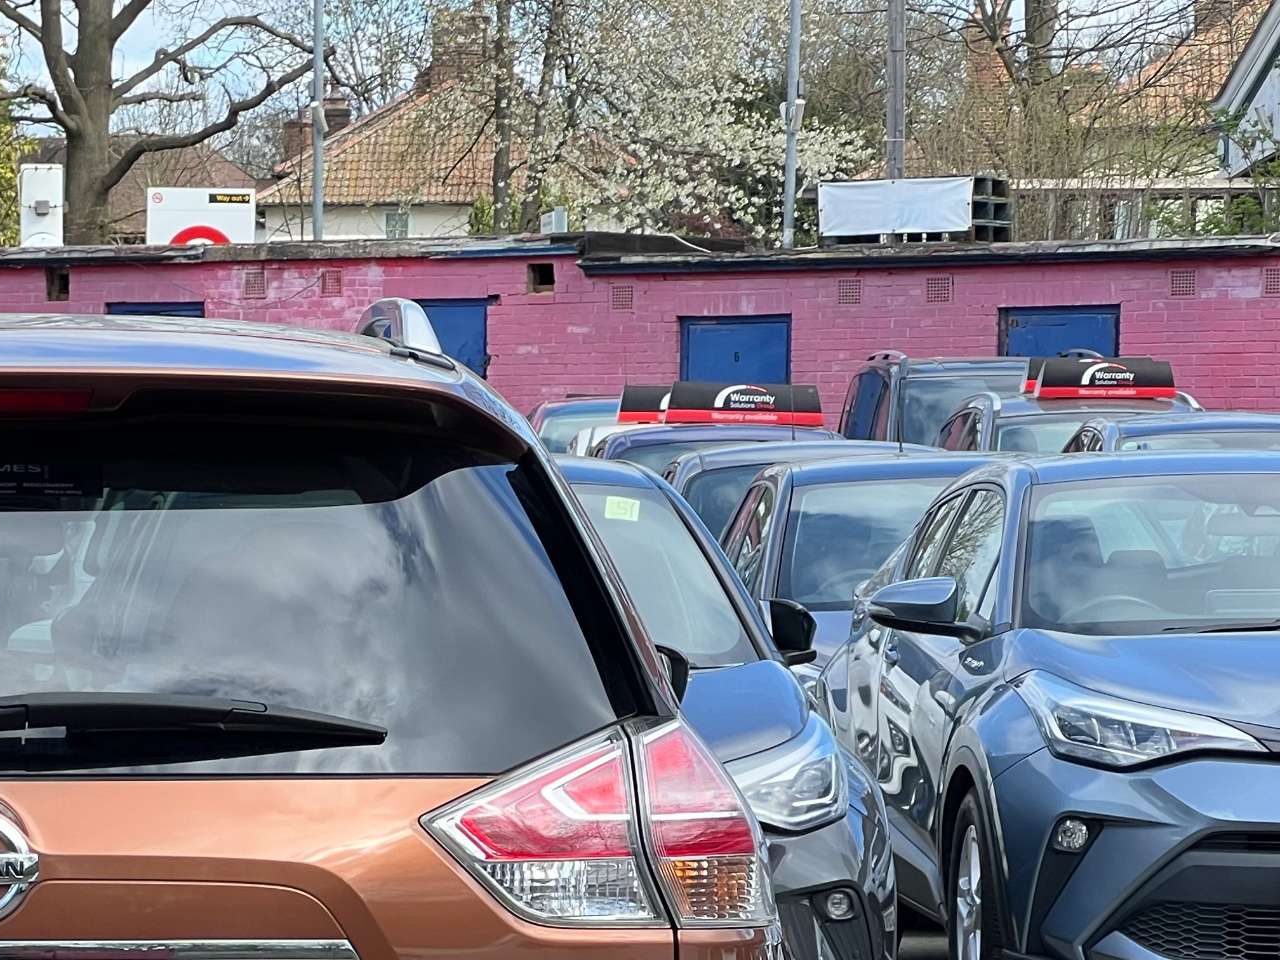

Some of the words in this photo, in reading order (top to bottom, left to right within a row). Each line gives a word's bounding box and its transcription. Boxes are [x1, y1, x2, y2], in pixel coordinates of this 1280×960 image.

[216, 195, 230, 203] Way
[1094, 371, 1135, 381] Warranty
[730, 392, 775, 404] Warranty
